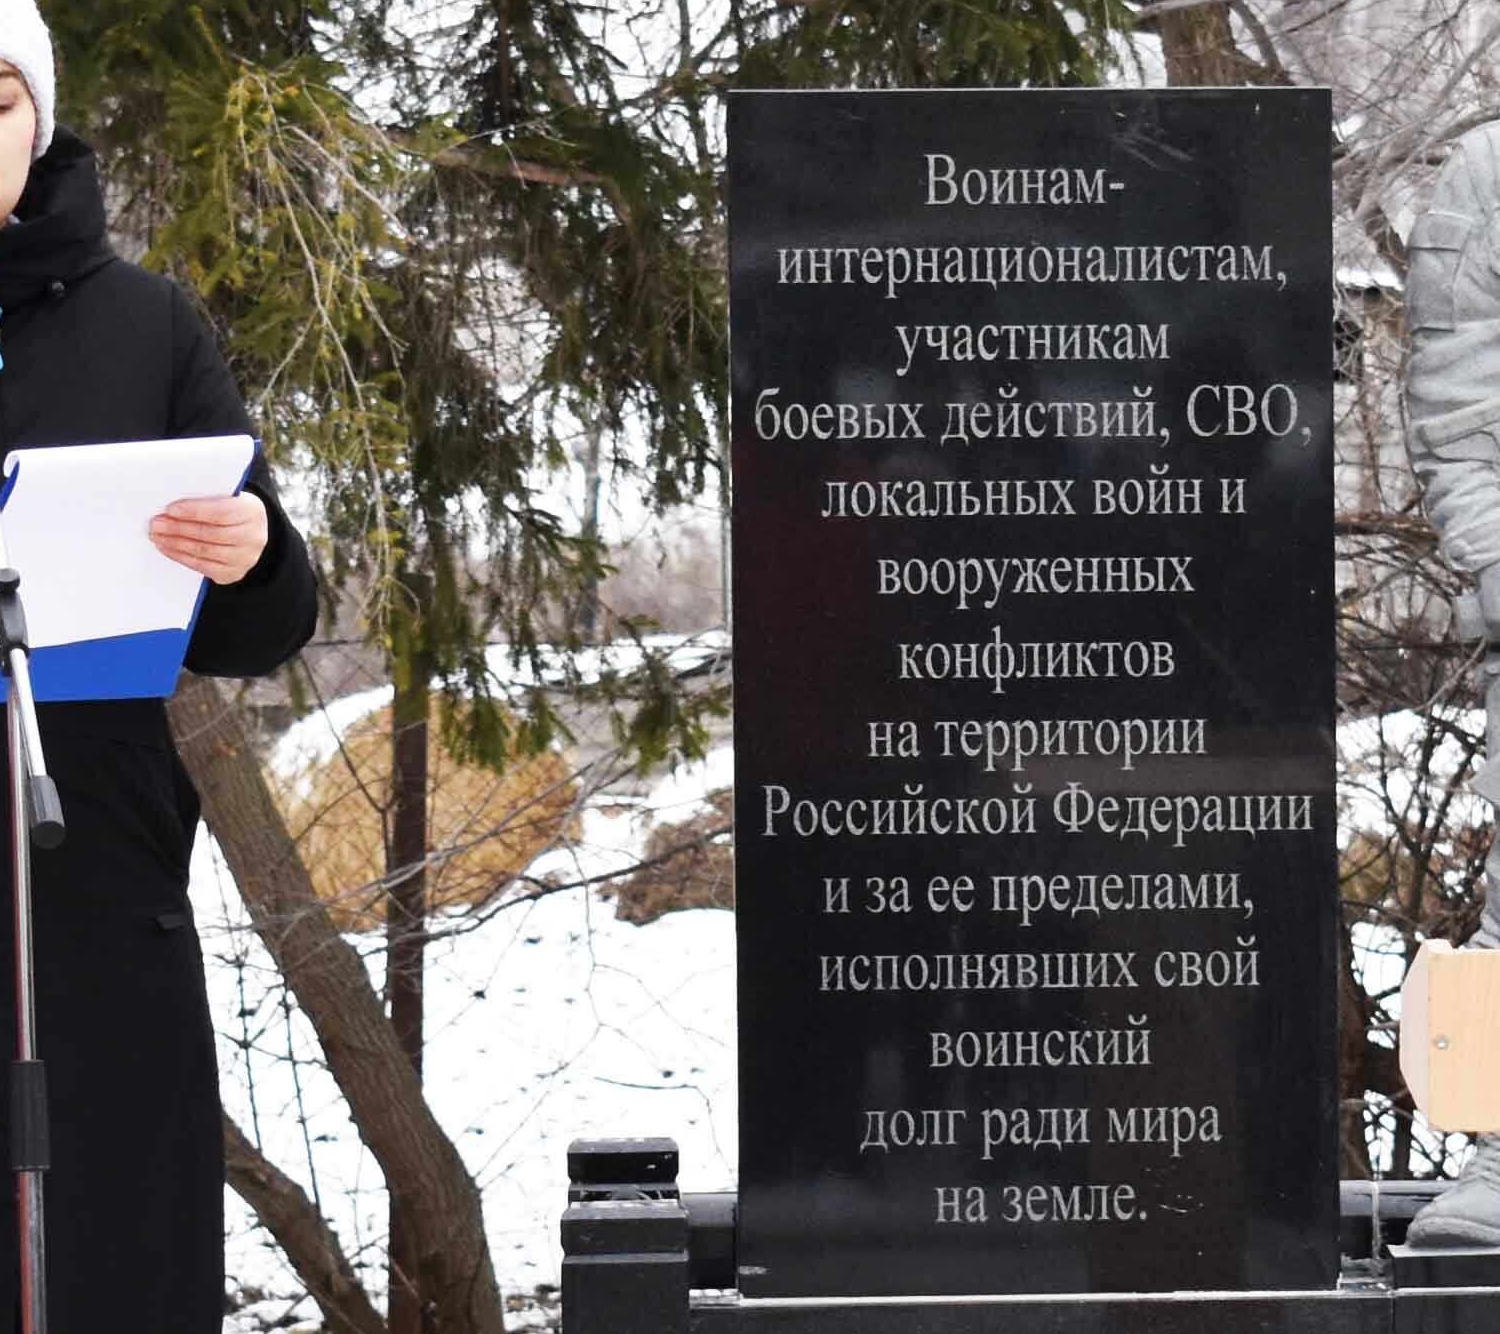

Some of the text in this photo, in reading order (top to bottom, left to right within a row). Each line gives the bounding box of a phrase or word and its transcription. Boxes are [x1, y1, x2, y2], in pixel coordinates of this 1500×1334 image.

[923, 153, 1125, 206] Воинам-
[776, 244, 1287, 299] интернационалистам,
[894, 323, 1171, 377] участникам
[754, 383, 1314, 447] боевых действий, СВО,
[821, 463, 1247, 518] локальных войн и
[877, 556, 1196, 610] вооруженных
[898, 624, 1175, 694] конфликтов
[867, 718, 1206, 772] на территории
[761, 781, 1313, 848] Российской Федерации
[823, 873, 1254, 927] и за ее пределами,
[819, 935, 1261, 992] исполнявших свой
[929, 1013, 1152, 1068] воинский
[859, 1105, 1223, 1161] долг ради мира
[935, 1184, 1147, 1223] на земле.
